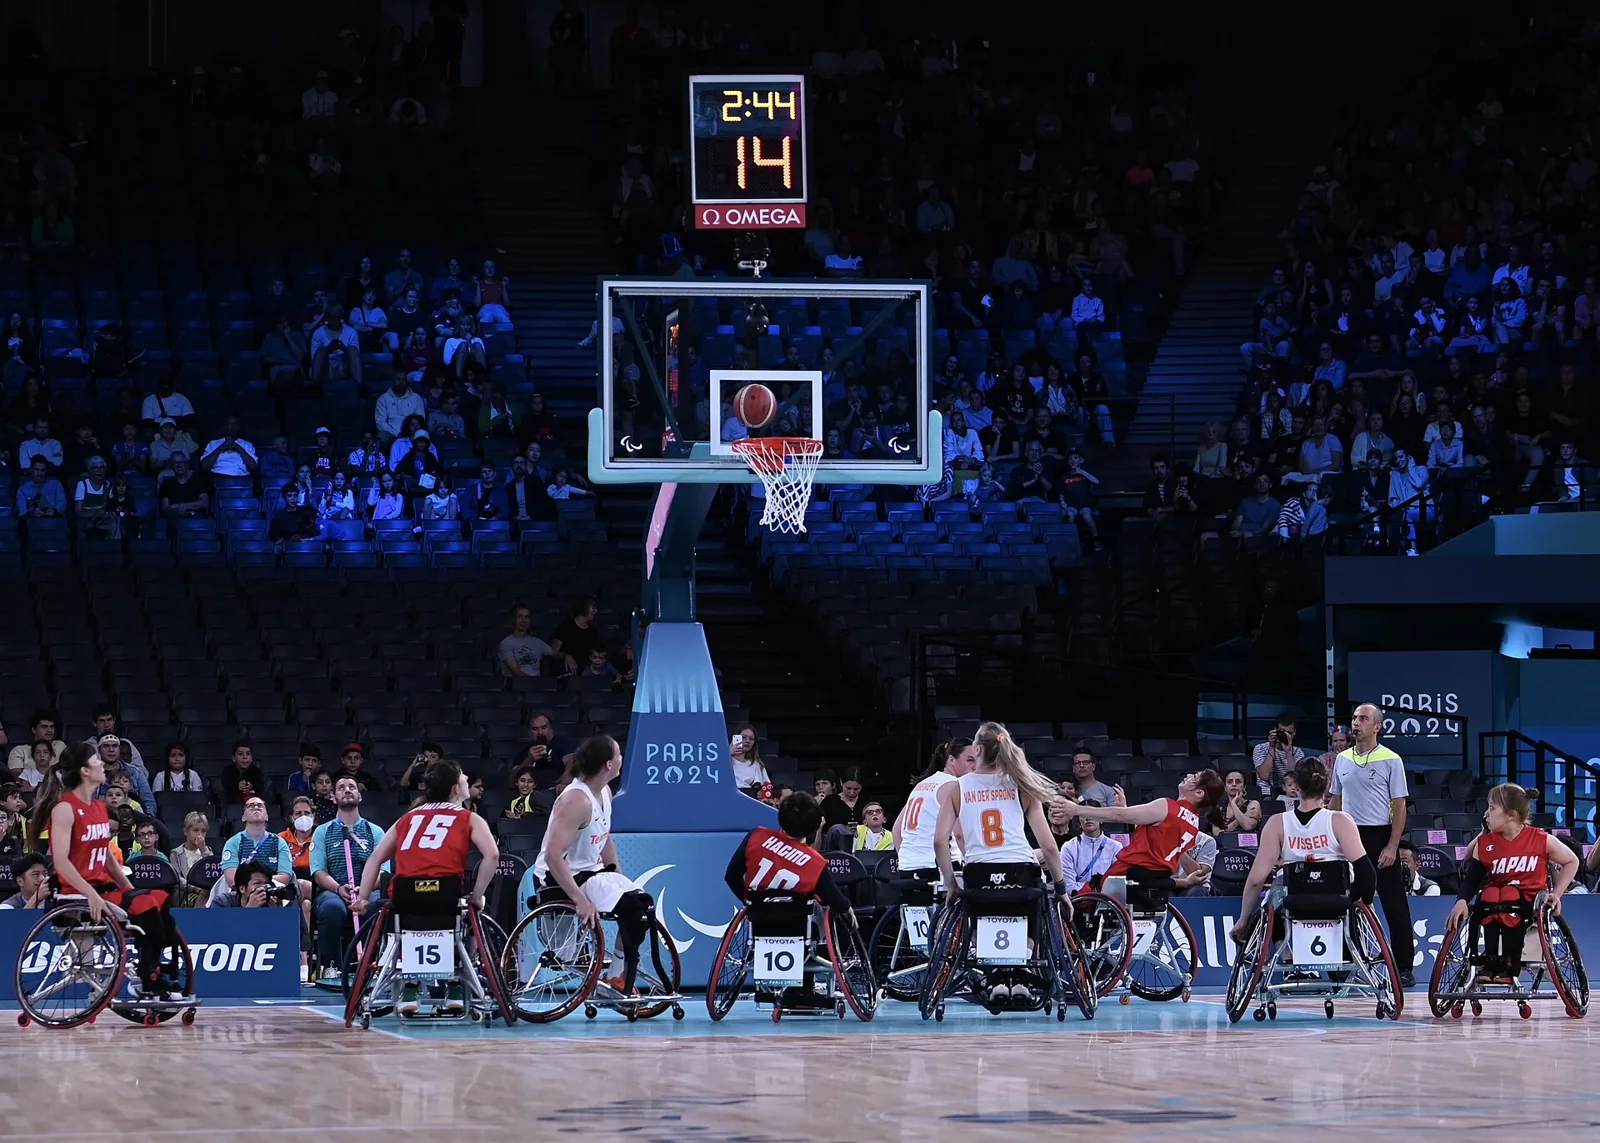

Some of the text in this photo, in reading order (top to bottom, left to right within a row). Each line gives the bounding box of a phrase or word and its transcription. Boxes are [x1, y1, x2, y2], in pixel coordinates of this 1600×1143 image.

[722, 90, 796, 122] 2:44
[736, 136, 792, 190] 14
[725, 208, 801, 225] OMEGA
[1382, 717, 1459, 738] 2024
[646, 765, 719, 785] 2024
[963, 788, 1016, 804] VAN DER SPRONG
[400, 814, 457, 851] 15
[981, 808, 1004, 848] 8
[1288, 834, 1329, 851] VISSER
[88, 846, 108, 870] 14
[134, 863, 161, 871] PARIS
[1224, 855, 1249, 864] PARIS
[1418, 853, 1440, 861] ARIS
[1491, 855, 1539, 875] JAPAN
[495, 868, 515, 876] 024
[828, 866, 850, 874] 024
[993, 929, 1010, 951] 8
[1132, 933, 1145, 949] 7
[1310, 935, 1327, 957] 6
[414, 944, 441, 965] 15
[763, 950, 795, 972] 10
